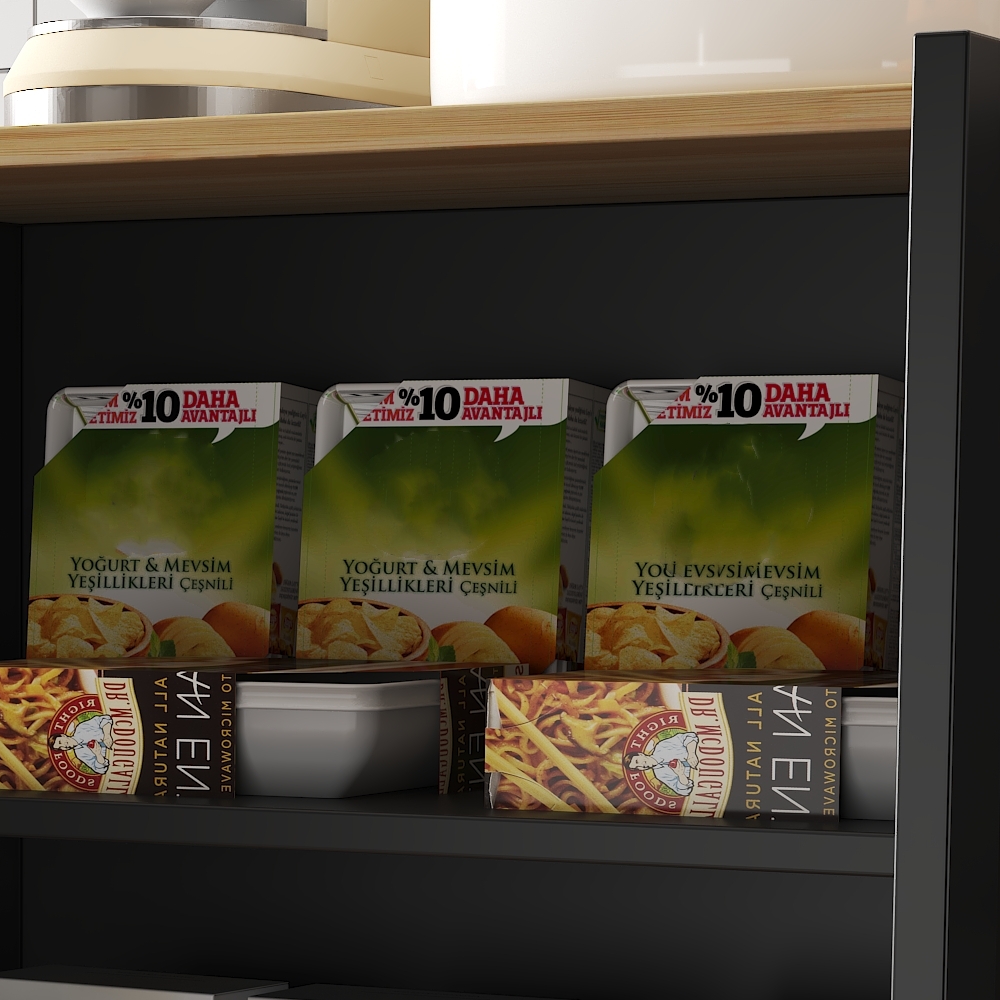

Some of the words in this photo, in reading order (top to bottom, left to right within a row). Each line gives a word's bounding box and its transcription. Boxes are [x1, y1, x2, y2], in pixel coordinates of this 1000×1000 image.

[122, 390, 180, 422] %10
[183, 390, 239, 408] DAHA
[398, 386, 461, 420] %10
[464, 387, 524, 405] DAHA
[695, 383, 762, 418] %10
[765, 383, 830, 402] DAHA
[181, 409, 256, 424] AVANTAJLI
[461, 406, 543, 422] AVANTAJLI
[763, 403, 850, 420] AVANTAJLI
[70, 556, 140, 572] YOĞURT
[145, 558, 158, 572] &
[164, 557, 231, 573] MEVSİM
[342, 559, 418, 575] YOĞURT
[423, 561, 437, 576] &
[443, 560, 515, 576] MEVSİM
[68, 573, 173, 592] YEŞİLLİKLERİ
[340, 576, 453, 596] YEŞİLLİKLERİ
